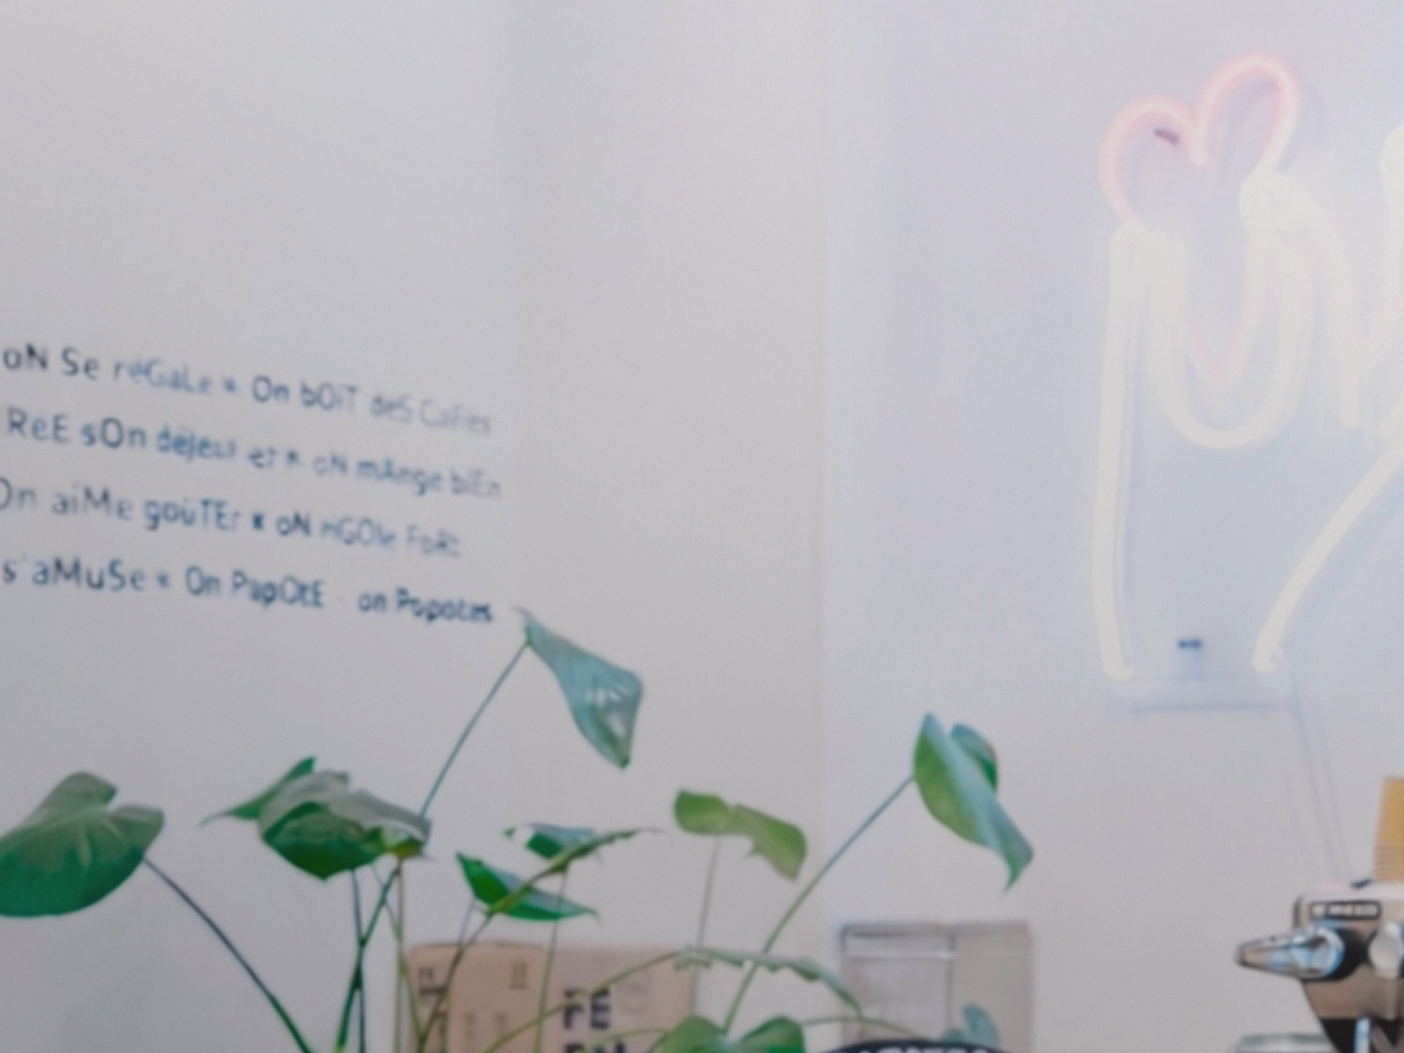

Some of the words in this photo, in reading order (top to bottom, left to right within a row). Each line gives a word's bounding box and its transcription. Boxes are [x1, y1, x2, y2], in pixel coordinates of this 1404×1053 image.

[61, 346, 100, 381] Se
[252, 375, 291, 404] On
[186, 566, 221, 597] On
